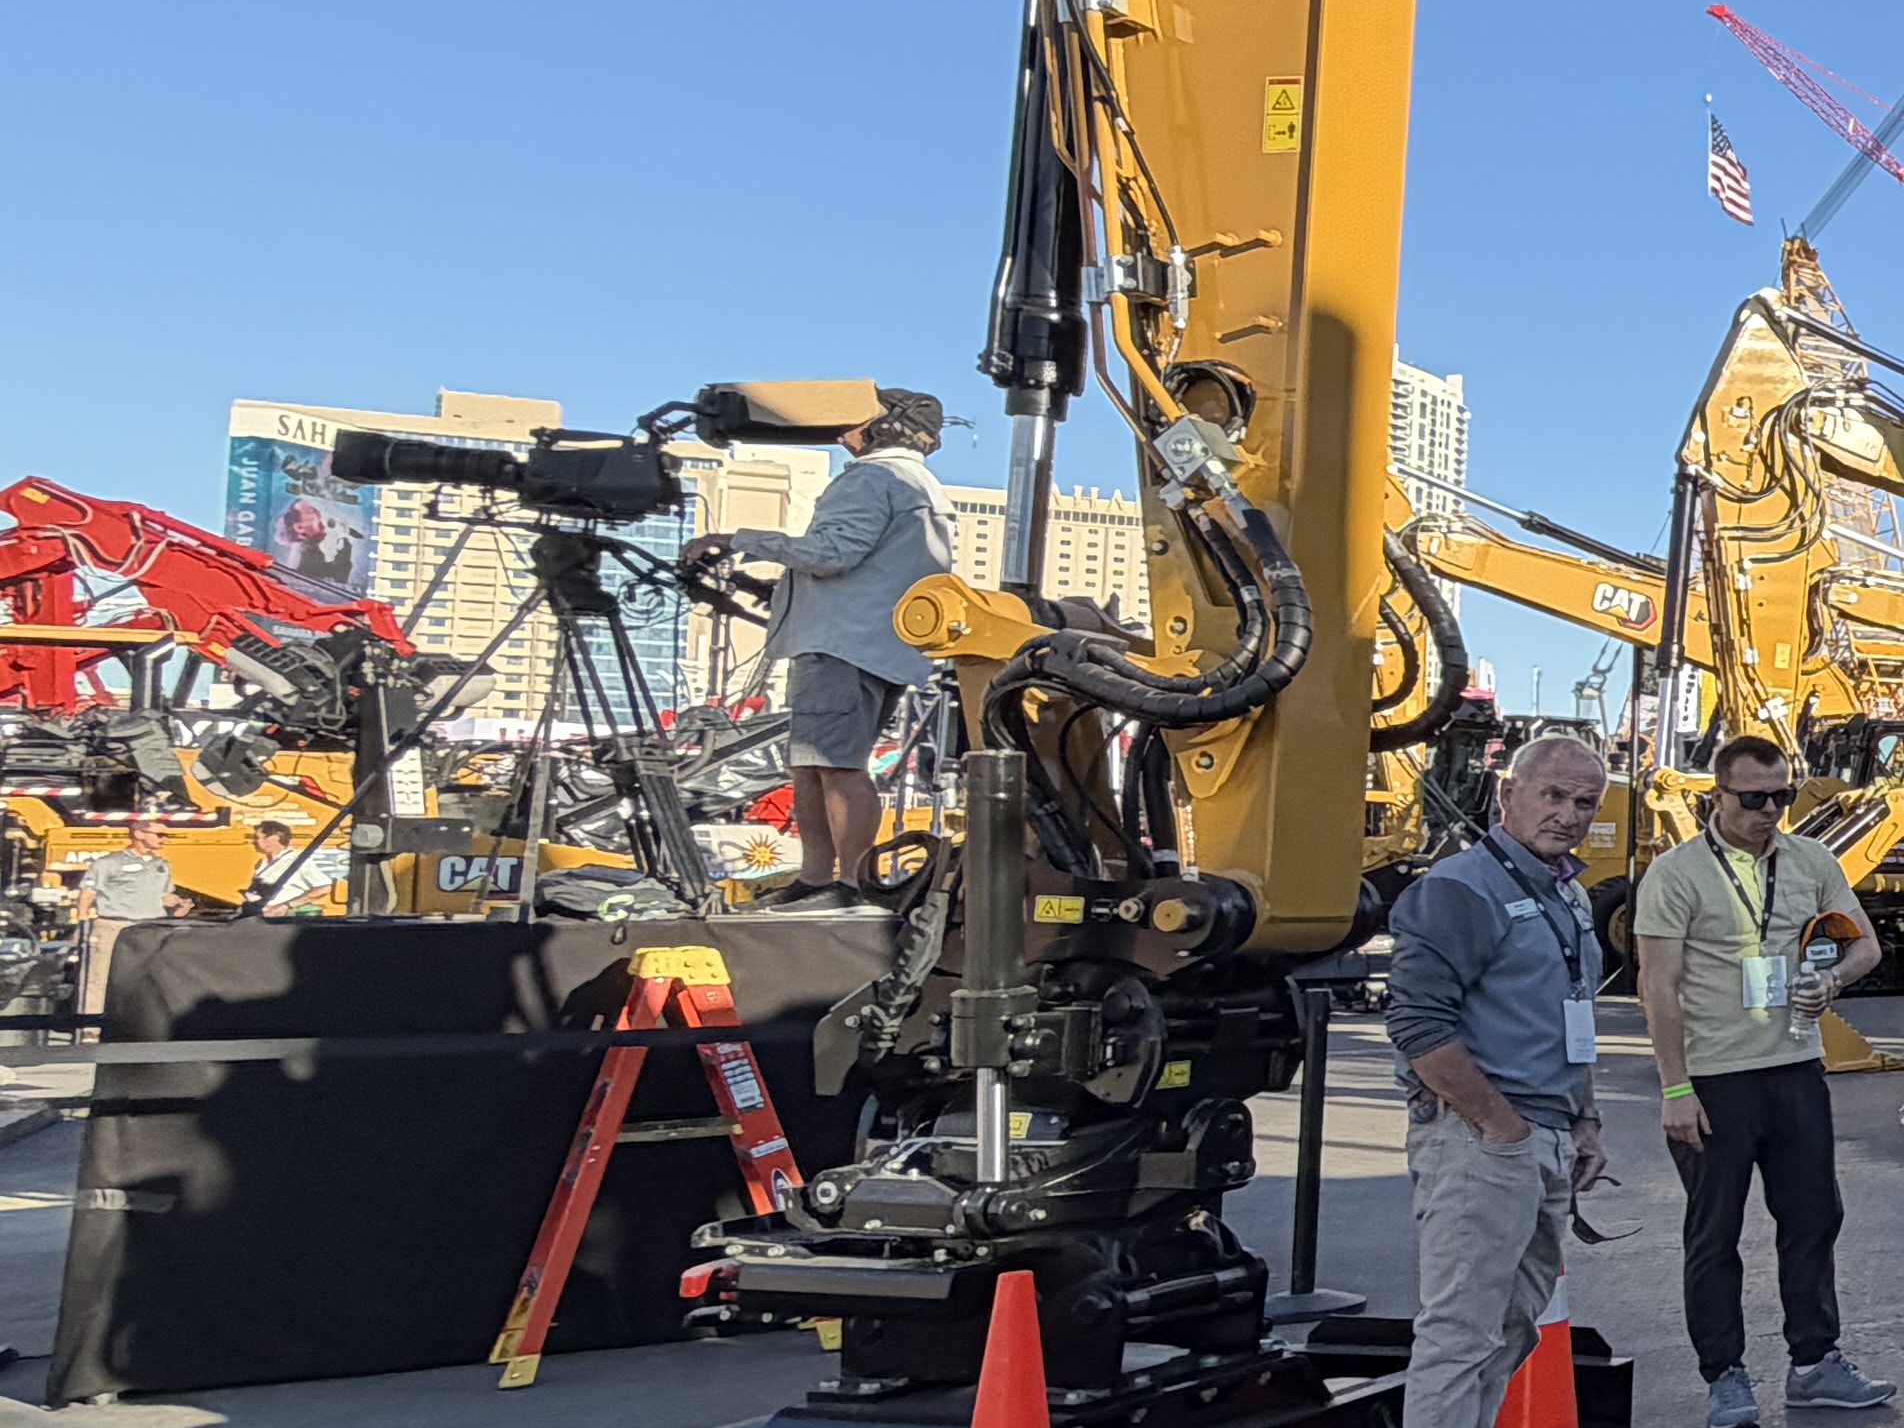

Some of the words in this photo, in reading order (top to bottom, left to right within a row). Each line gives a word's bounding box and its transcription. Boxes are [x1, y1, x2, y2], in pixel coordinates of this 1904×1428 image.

[277, 414, 335, 447] SAH
[1592, 582, 1647, 622] CAT
[438, 855, 519, 891] CAT
